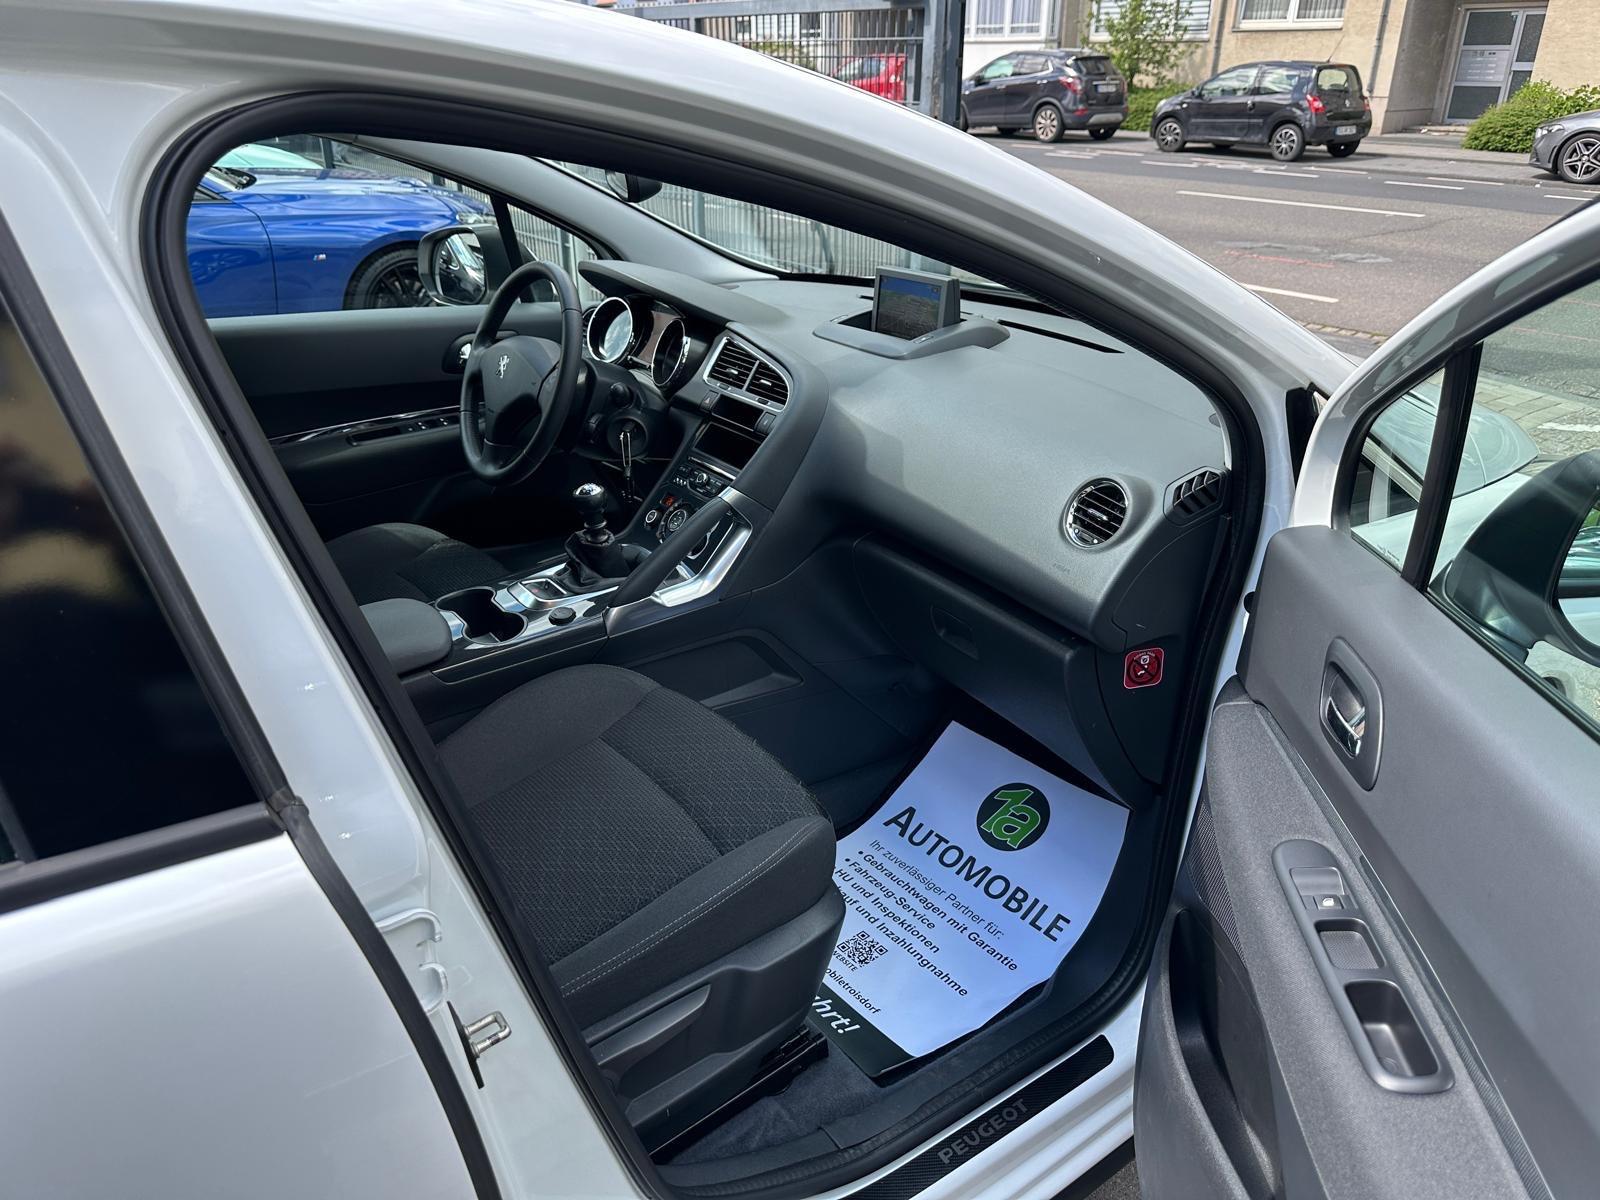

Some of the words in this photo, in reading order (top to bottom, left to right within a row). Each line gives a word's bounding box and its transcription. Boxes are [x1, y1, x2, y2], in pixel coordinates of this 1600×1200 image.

[979, 788, 1041, 849] 1a
[835, 868, 854, 882] HU
[851, 882, 874, 899] und
[871, 897, 940, 953] Inspektionen
[848, 861, 936, 930] Fahrzeug-Service
[863, 854, 947, 919] Gebrauchtwagen
[946, 917, 968, 934] mit
[967, 932, 1018, 971] Garantie
[869, 840, 885, 852] Ihr
[883, 850, 946, 897] zuverlässiger
[945, 893, 985, 924] Partner
[984, 922, 1004, 940] für:
[883, 806, 1071, 942] AUTOMOBILE
[855, 905, 880, 924] und
[876, 922, 968, 996] Inzahlungnahme
[812, 995, 860, 1034] hrt!
[937, 1098, 1028, 1164] PEUGEOT
